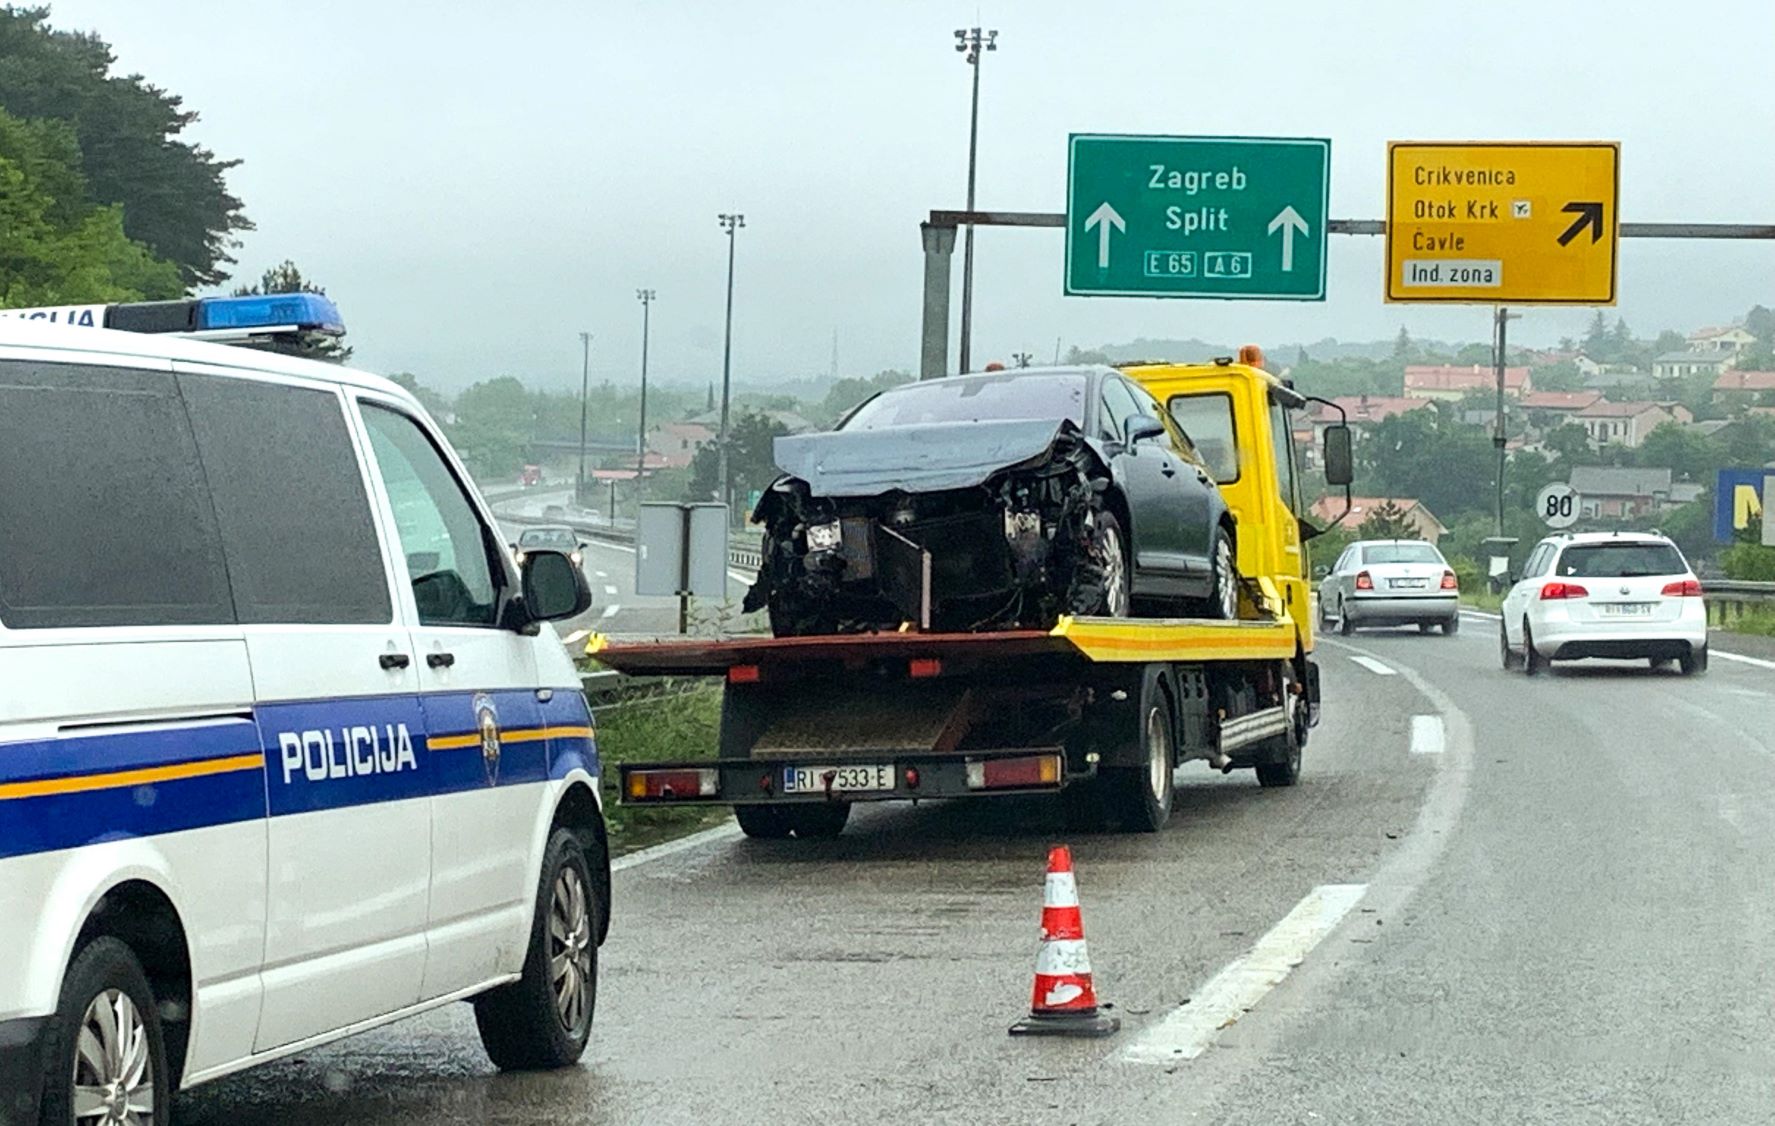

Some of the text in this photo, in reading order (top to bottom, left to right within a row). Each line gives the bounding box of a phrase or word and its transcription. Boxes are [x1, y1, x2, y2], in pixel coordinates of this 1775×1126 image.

[1148, 165, 1247, 195] Zagreb
[1415, 166, 1516, 186] Crikvenica
[1415, 200, 1498, 219] Otok Krk
[1166, 206, 1229, 236] Split
[1413, 227, 1465, 251] Čavle
[1151, 254, 1193, 273] E 65
[1214, 256, 1241, 274] A 6
[1412, 264, 1493, 283] Ind. zona
[1546, 494, 1573, 518] 80
[278, 723, 418, 785] POLICIJA
[797, 770, 815, 789] RI
